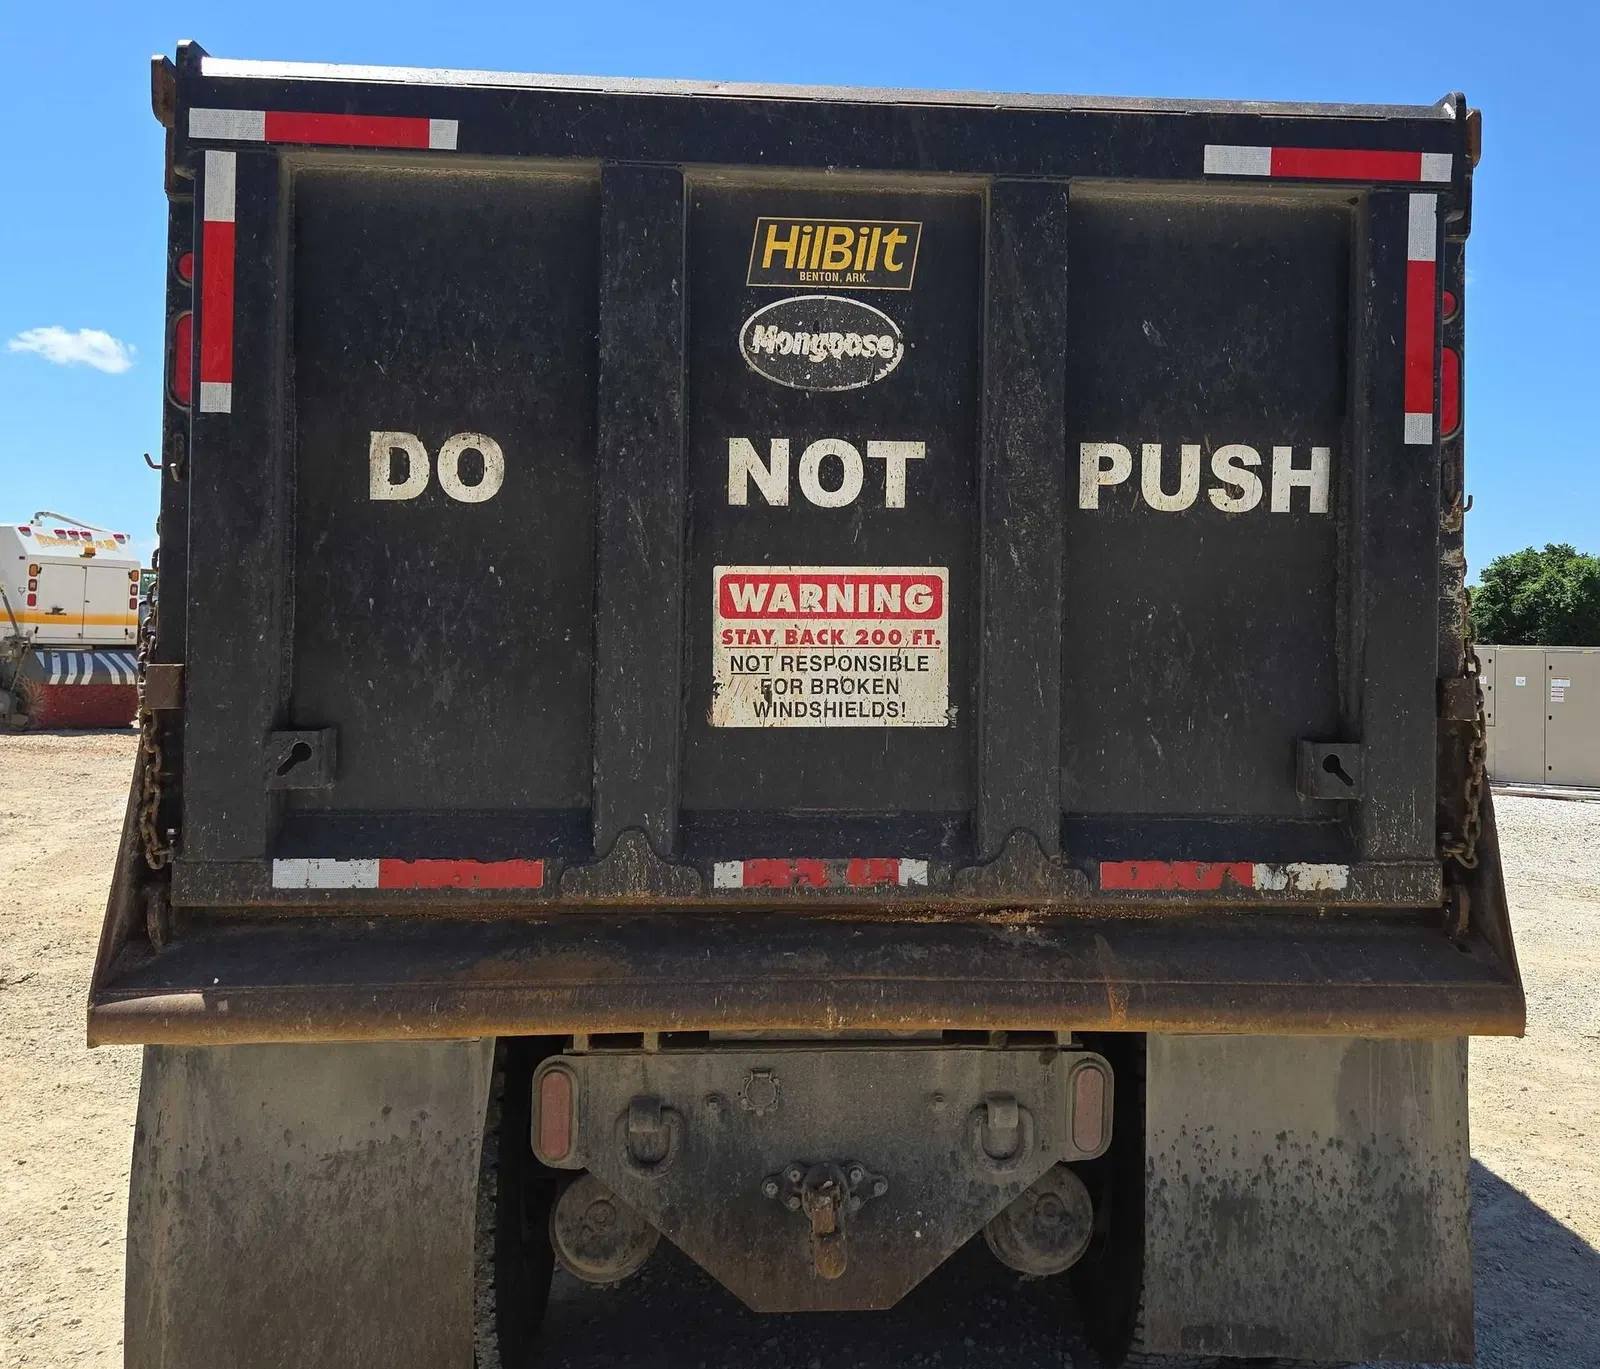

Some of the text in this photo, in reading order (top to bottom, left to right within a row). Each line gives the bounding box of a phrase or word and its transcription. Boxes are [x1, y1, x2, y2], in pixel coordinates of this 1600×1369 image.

[762, 224, 907, 272] HilBilt
[799, 271, 870, 283] BENTON, ARK.
[751, 324, 894, 363] Mongoose
[369, 431, 1331, 513] DO NOT PUSH
[727, 583, 934, 613] WARNING
[722, 629, 941, 646] STAY BACK 200 FT.
[730, 655, 929, 672] NOT RESPONSIBLE
[761, 678, 899, 695] FOR BROKEN
[753, 701, 906, 718] WINDSHIELDS!
